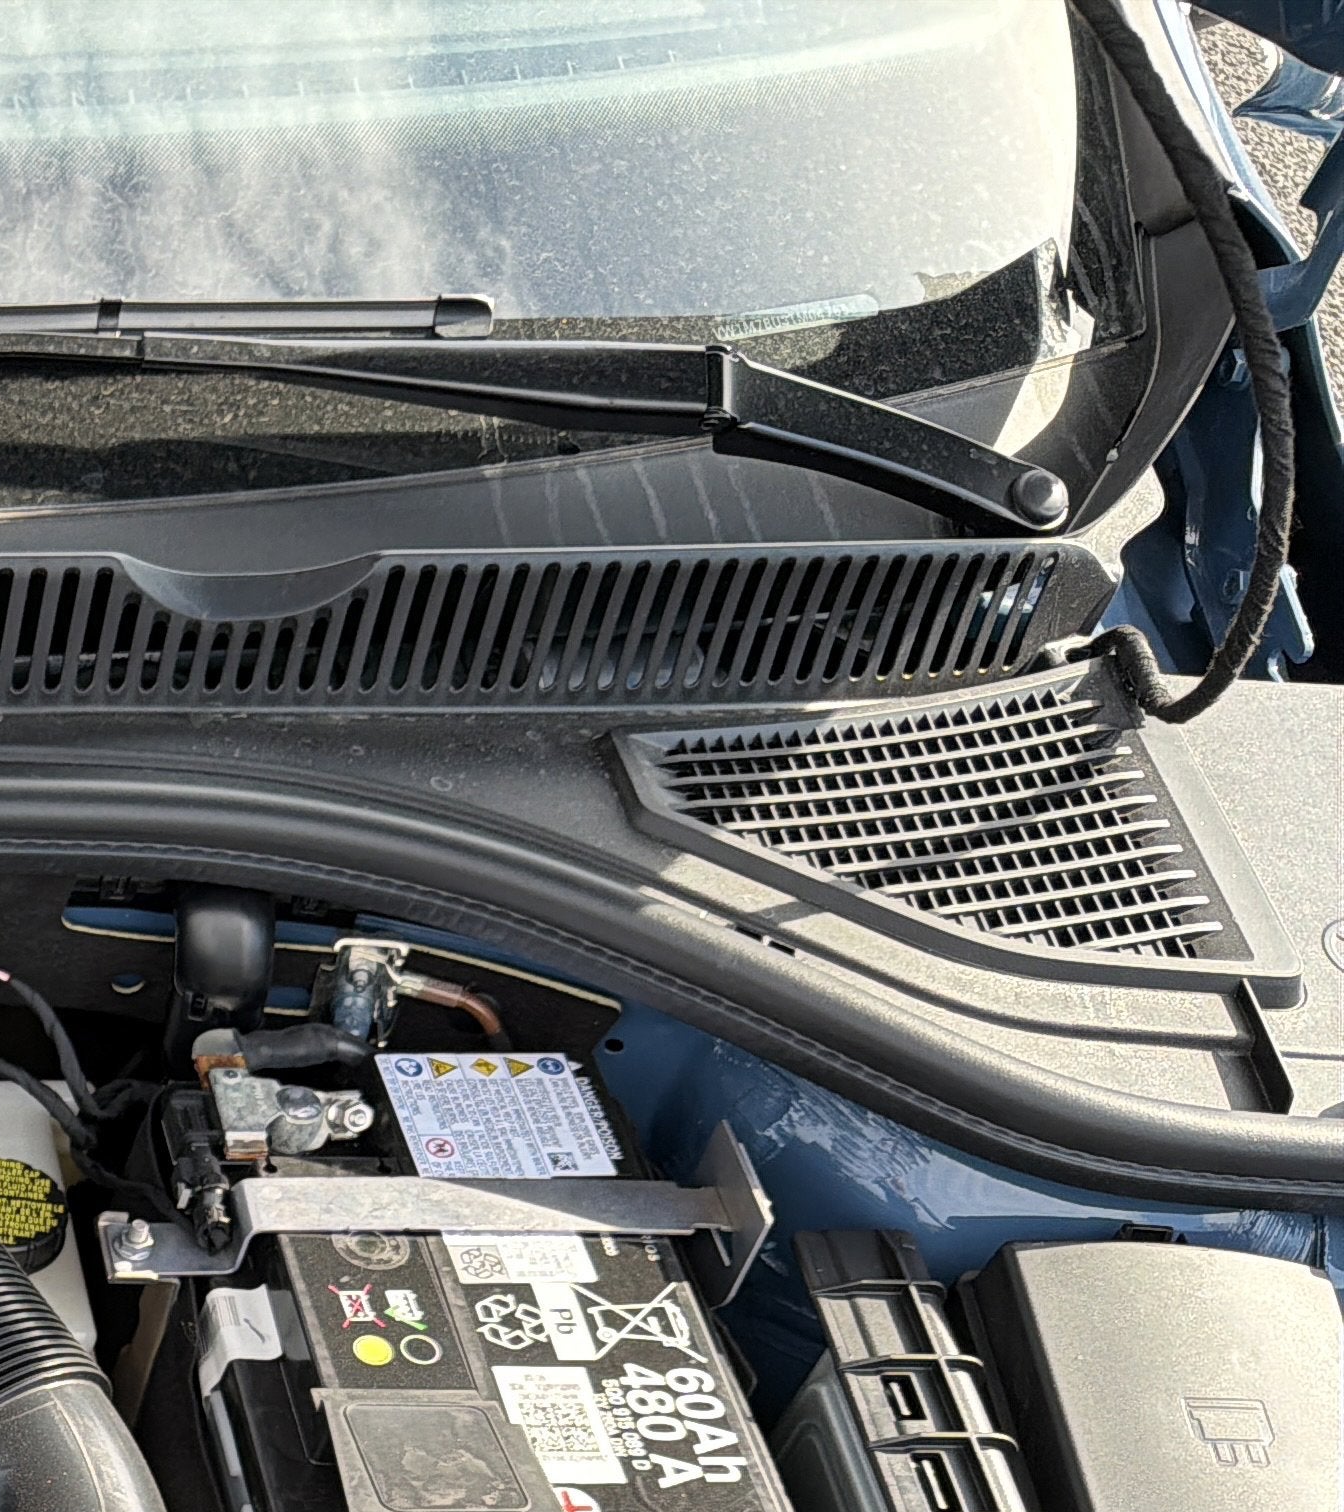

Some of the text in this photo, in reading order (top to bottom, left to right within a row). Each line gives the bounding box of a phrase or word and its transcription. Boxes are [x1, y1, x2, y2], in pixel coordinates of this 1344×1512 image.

[549, 1308, 577, 1335] Pb
[619, 1362, 705, 1488] 480 A
[665, 1366, 748, 1483] 60Ah
